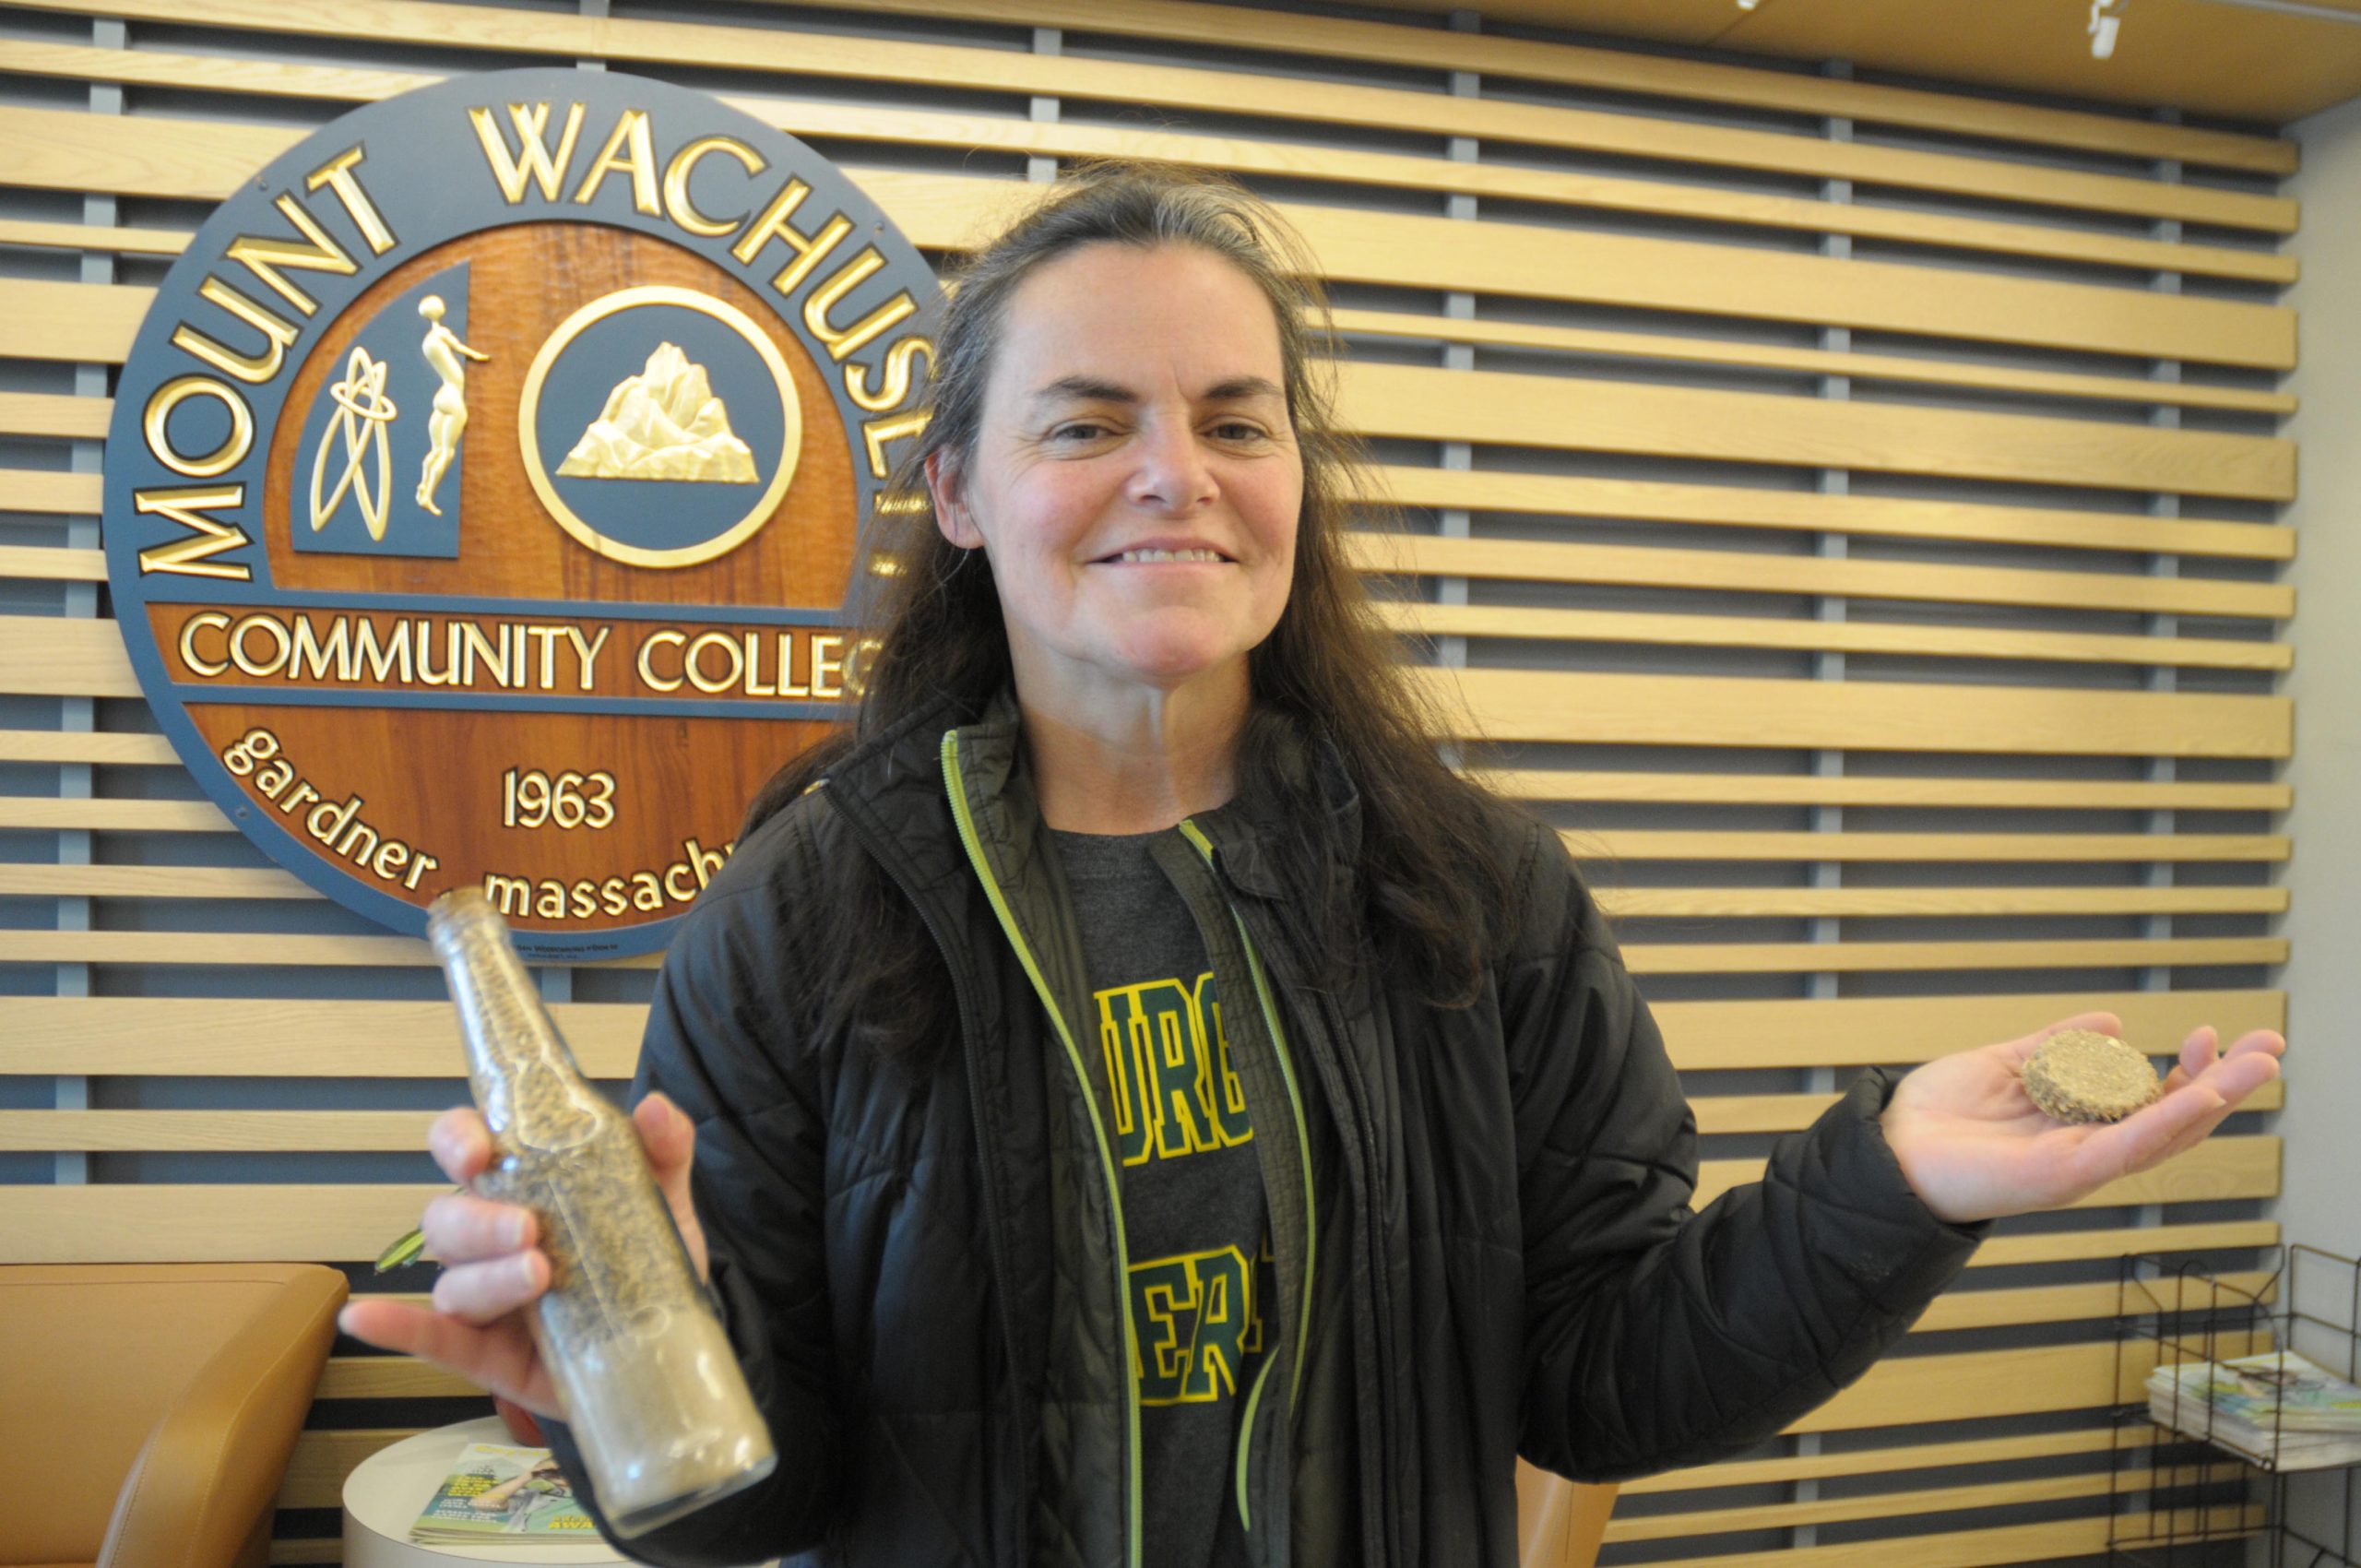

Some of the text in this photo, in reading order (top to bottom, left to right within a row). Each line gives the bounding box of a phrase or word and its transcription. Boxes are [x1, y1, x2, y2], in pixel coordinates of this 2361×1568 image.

[135, 144, 397, 580] MOUNT
[179, 611, 885, 698] COMMUNITY COLLEG
[222, 727, 736, 920] gardner massach
[503, 767, 618, 829] 1963
